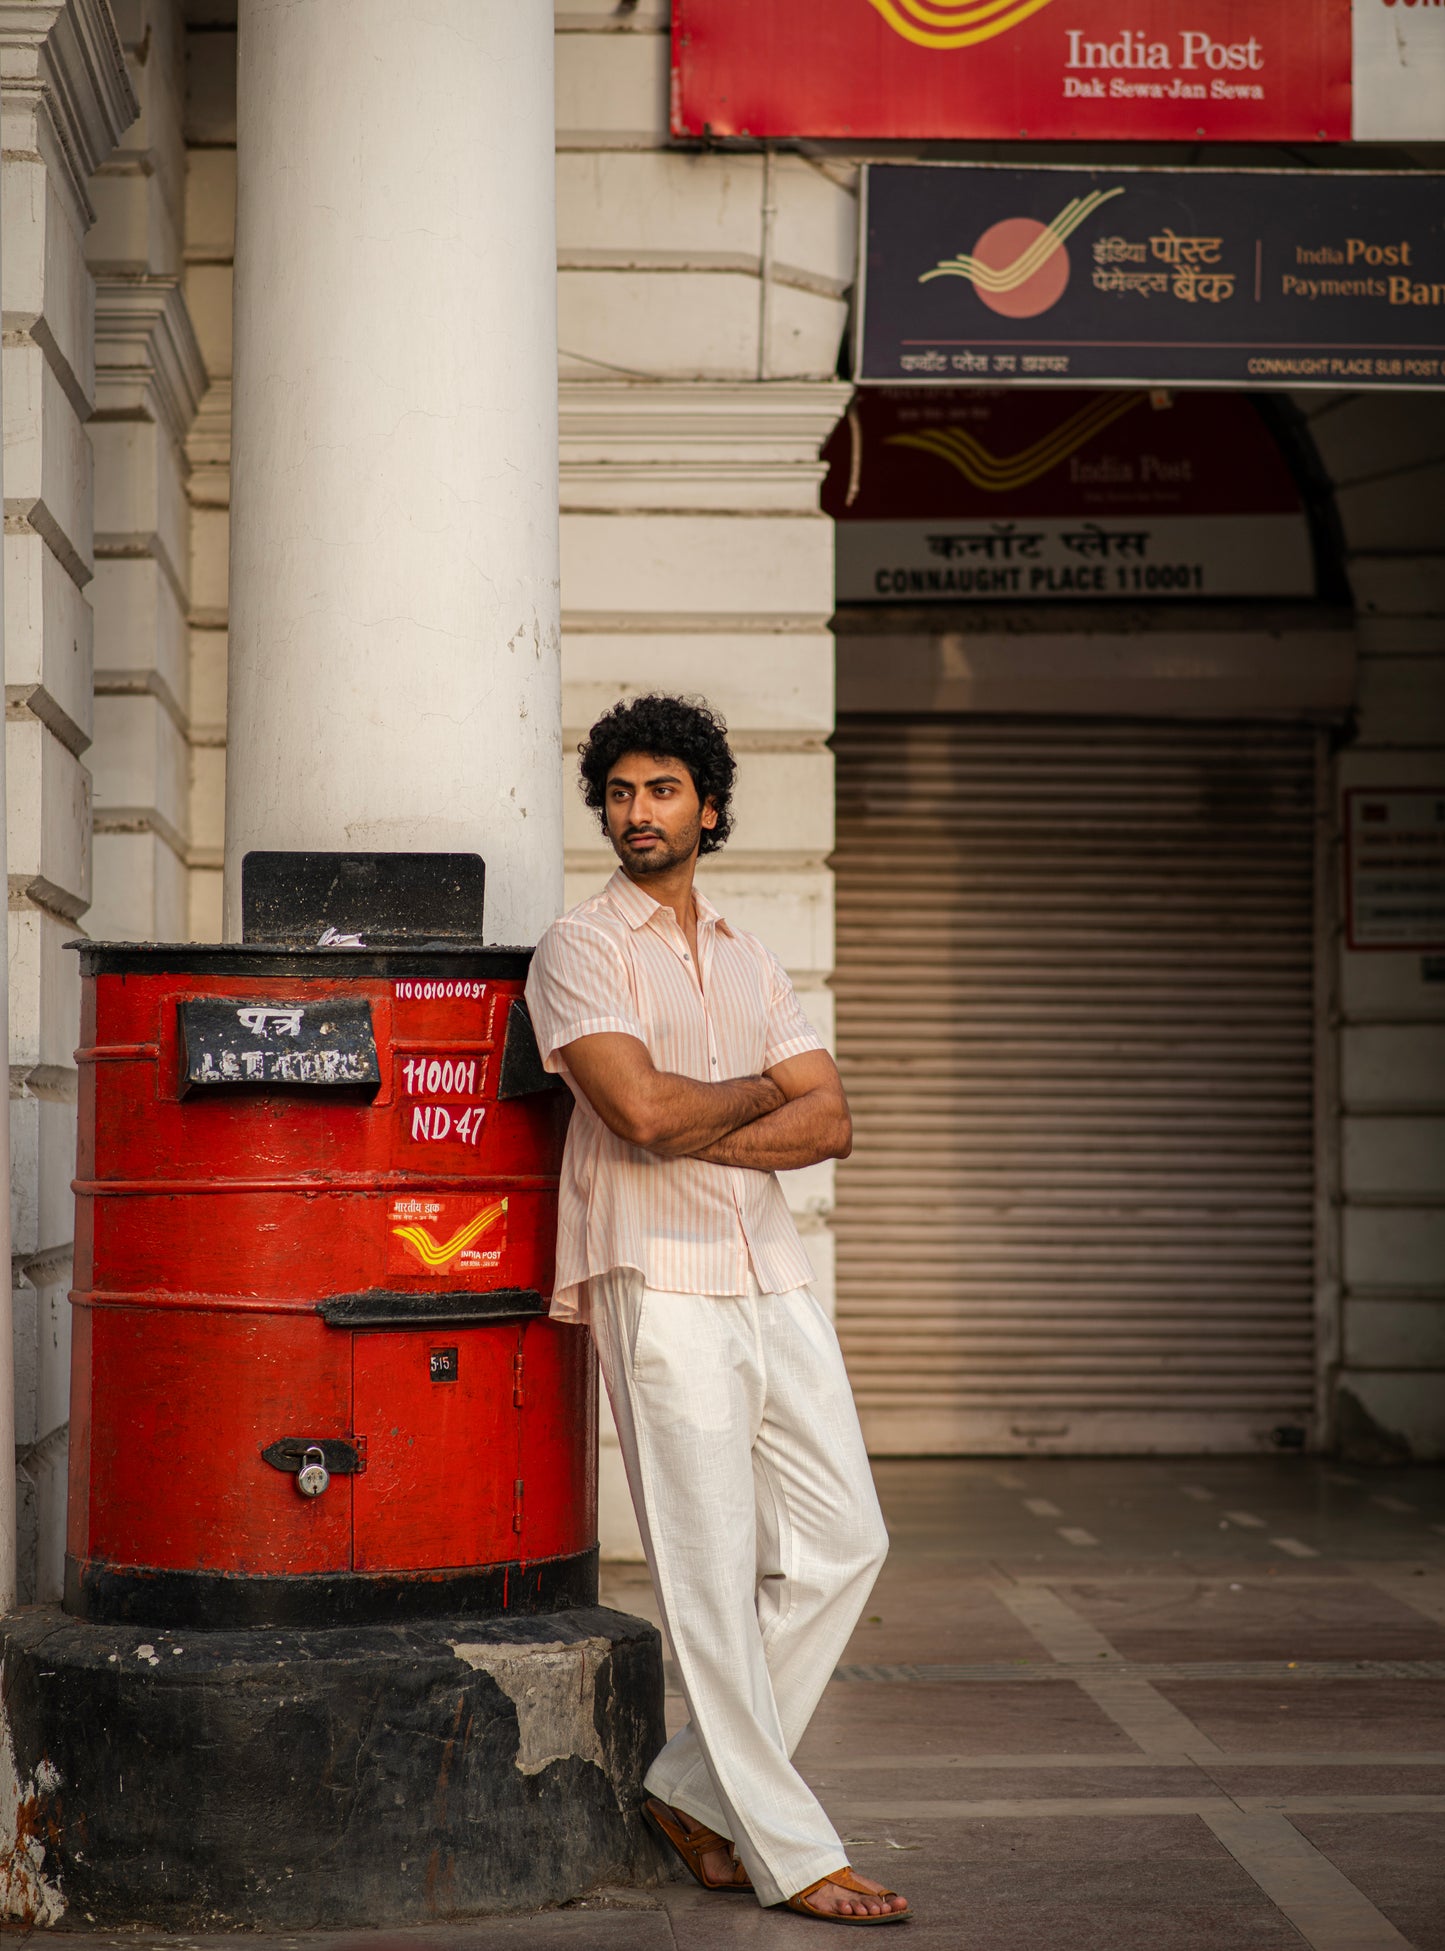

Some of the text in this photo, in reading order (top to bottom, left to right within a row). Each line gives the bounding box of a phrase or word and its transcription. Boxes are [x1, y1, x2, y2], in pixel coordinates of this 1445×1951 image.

[1064, 30, 1265, 70] India Post
[1063, 77, 1106, 98] Dak
[1210, 79, 1265, 100] Sewa
[1092, 228, 1224, 265] इंडिया पोस्ट
[1295, 238, 1412, 267] India Post
[1171, 264, 1237, 302] बैंक
[1281, 273, 1387, 301] Payments
[1247, 357, 1329, 375] CONNAUGHT
[1330, 358, 1373, 375] PLACE
[1375, 358, 1402, 376] SUB
[1404, 359, 1439, 376] POST
[926, 522, 1150, 560] कनॉट प्लेस
[874, 563, 1204, 594] CONNAUGHT PLACE 110001
[395, 982, 487, 999] 110001000097
[236, 1007, 304, 1036] पत्र
[403, 1058, 476, 1095] 110001
[393, 1199, 440, 1214] भारतीय डाक
[461, 1250, 501, 1260] INDIA POST
